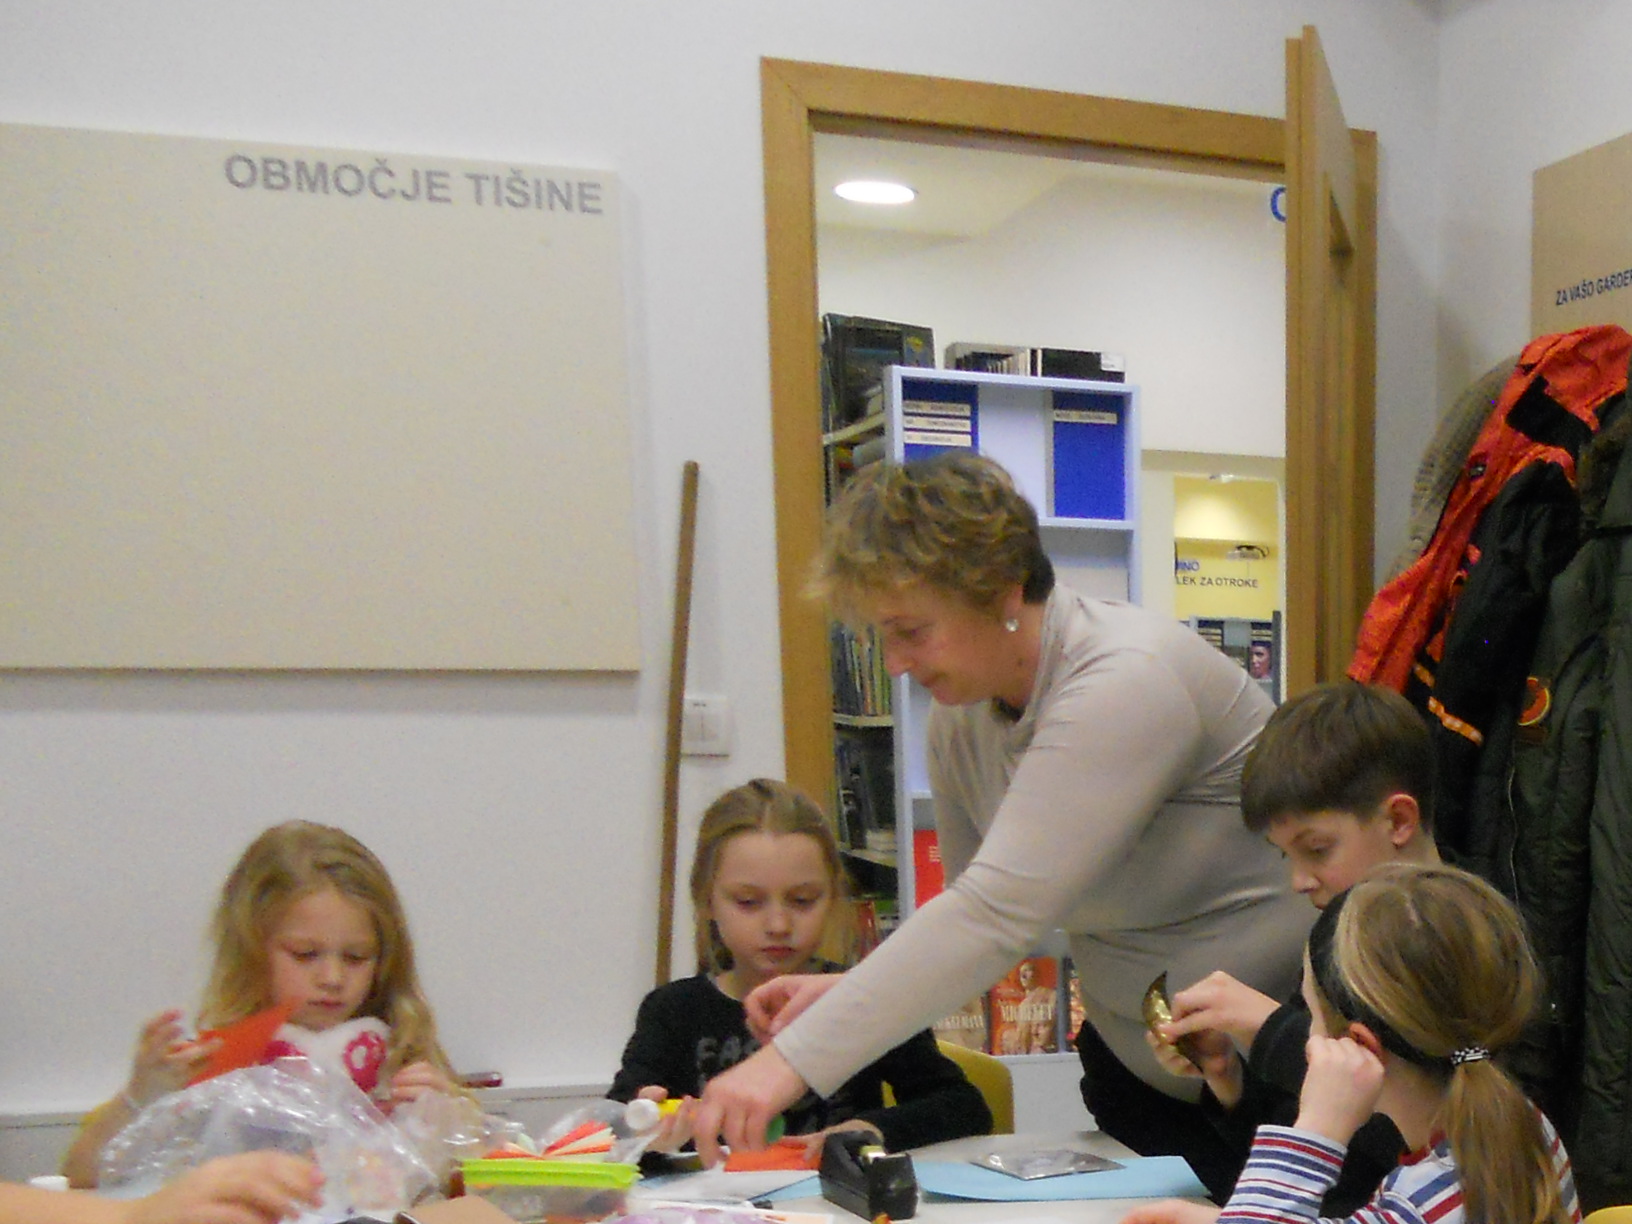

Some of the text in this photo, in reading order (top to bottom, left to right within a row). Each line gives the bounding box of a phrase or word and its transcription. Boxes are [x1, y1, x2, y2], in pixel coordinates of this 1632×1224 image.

[224, 153, 604, 216] OBMOČJE TIŠINE
[1555, 289, 1568, 306] ZA
[1569, 279, 1594, 301] VAŠO
[1199, 577, 1214, 586] ZA
[1215, 576, 1259, 589] OTROKE
